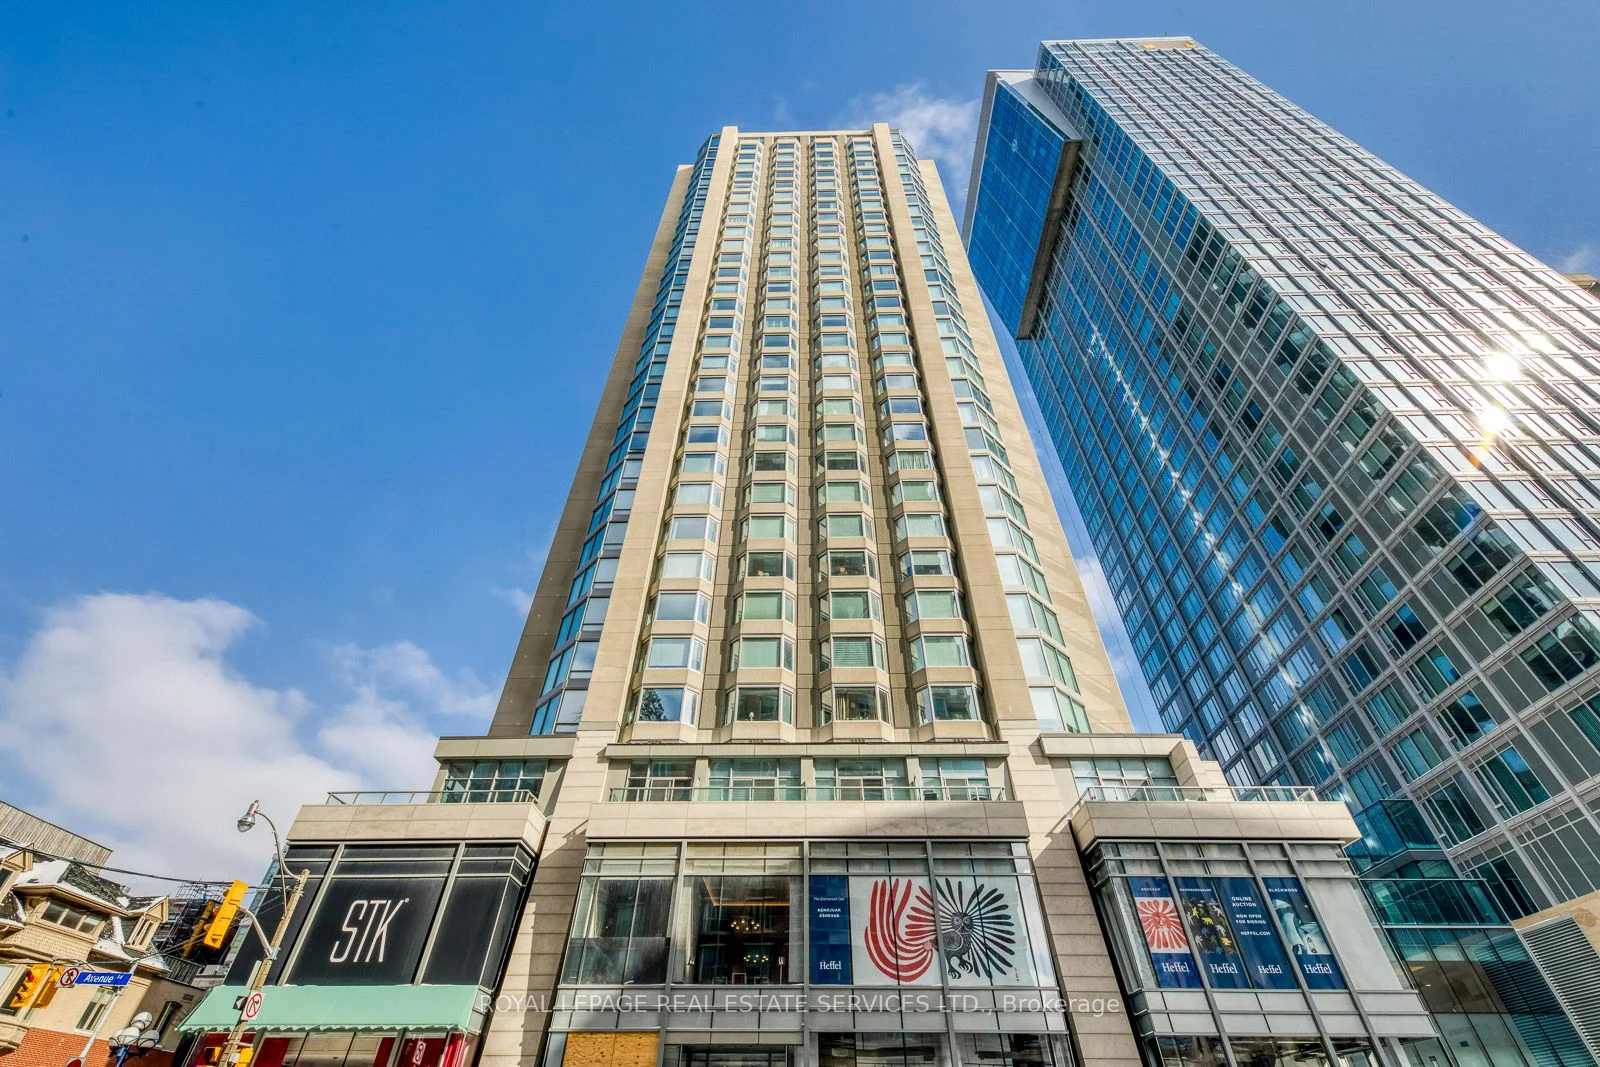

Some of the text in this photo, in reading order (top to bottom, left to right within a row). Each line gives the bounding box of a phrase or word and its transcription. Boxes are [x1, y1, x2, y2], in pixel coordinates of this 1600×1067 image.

[329, 899, 405, 963] STK
[819, 961, 842, 970] Heffel
[1161, 962, 1190, 973] Heffel
[1209, 963, 1239, 974] Heffel
[1257, 964, 1283, 974] Heffel
[1303, 963, 1333, 974] Heffel
[83, 973, 114, 984] Avenue
